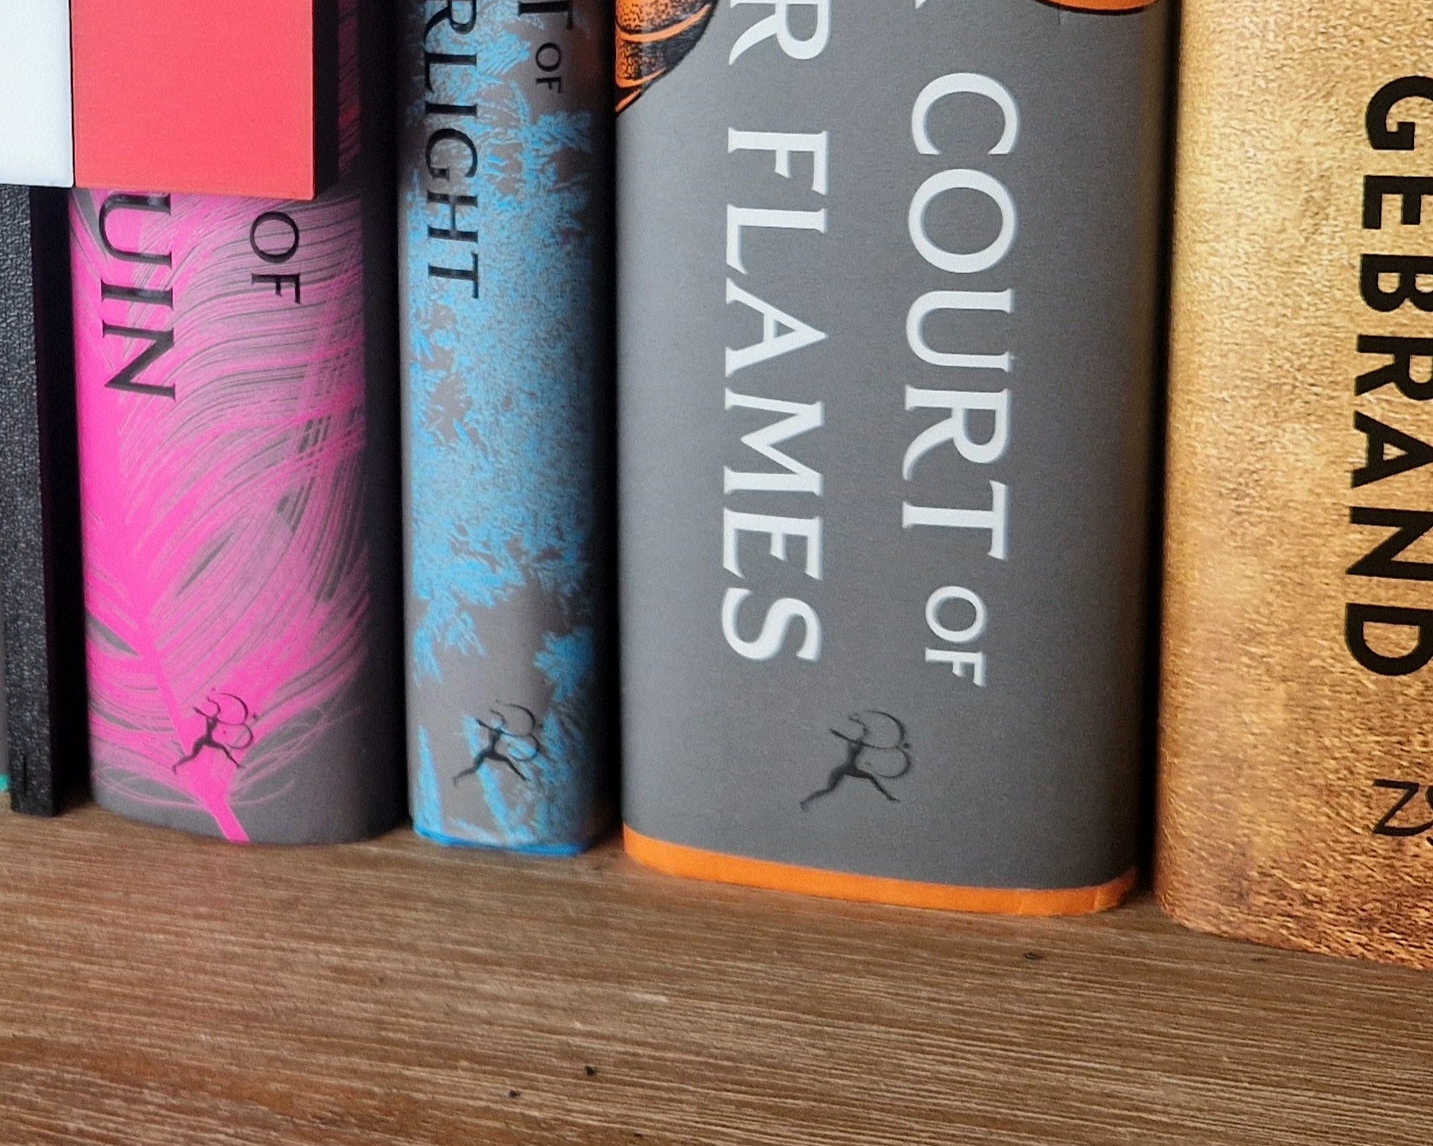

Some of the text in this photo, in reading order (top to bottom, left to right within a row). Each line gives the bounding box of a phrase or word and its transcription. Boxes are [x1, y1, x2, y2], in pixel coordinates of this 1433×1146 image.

[535, 42, 564, 93] OF
[98, 193, 177, 402] UIN
[249, 211, 301, 305] OF
[901, 71, 1019, 560] COURT
[720, 126, 830, 662] FLAMES
[1345, 75, 1433, 676] GEBRAND
[924, 585, 988, 687] OF
